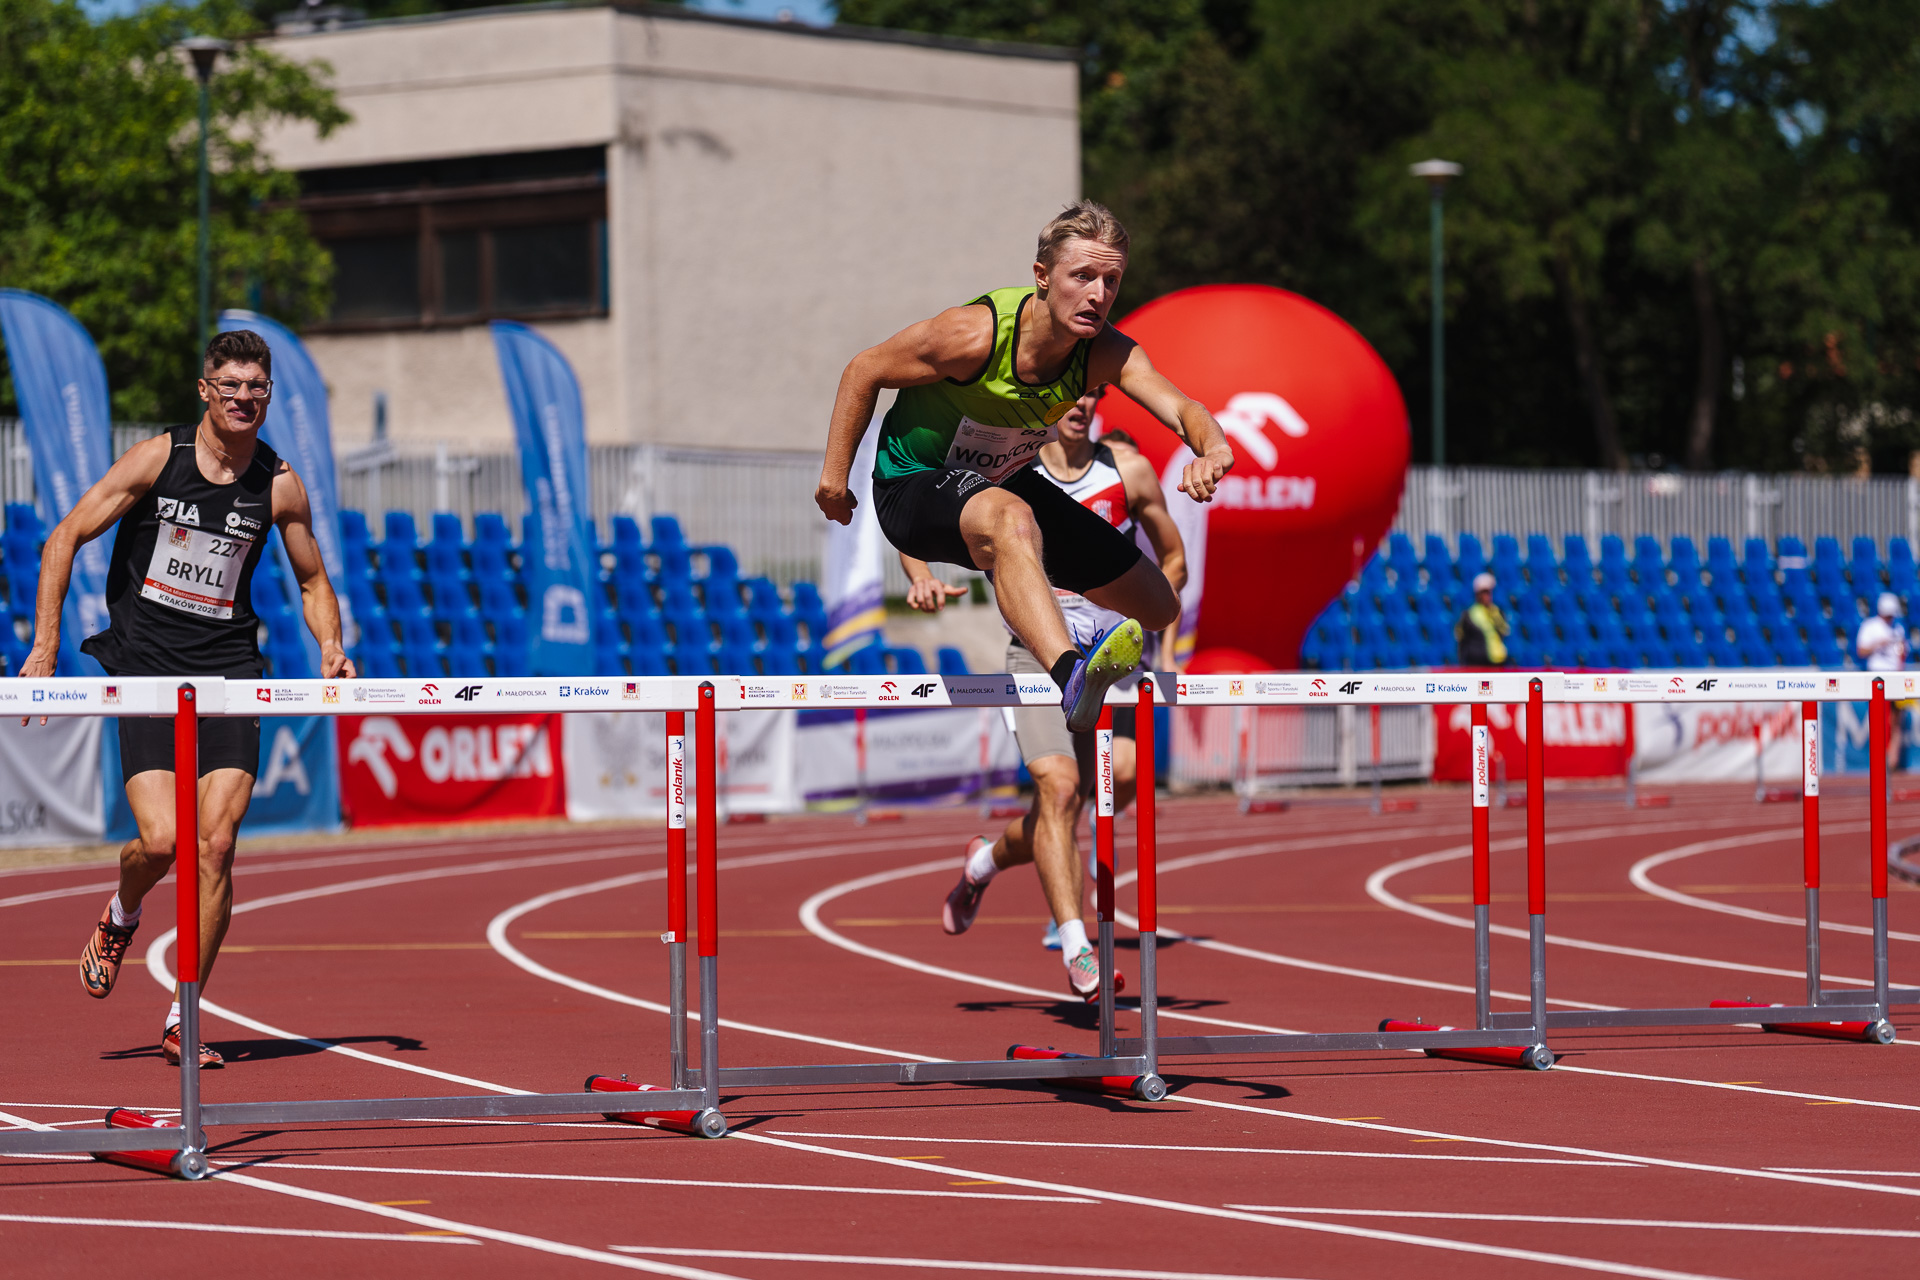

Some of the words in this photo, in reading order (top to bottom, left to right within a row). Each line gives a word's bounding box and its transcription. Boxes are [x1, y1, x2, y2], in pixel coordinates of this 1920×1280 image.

[955, 440, 1046, 469] WODECKI
[1211, 475, 1317, 510] RLEN
[241, 519, 261, 530] OPOLE
[228, 527, 257, 540] OPOLS
[208, 539, 243, 559] 227
[166, 557, 224, 589] BRYLL
[158, 593, 197, 610] KRAKÓW
[196, 604, 218, 615] 2025
[455, 685, 483, 701] 4F
[574, 686, 610, 696] Kraków
[911, 683, 937, 698] 4F
[1019, 684, 1051, 694] Kraków
[1338, 681, 1363, 695] 4F
[1438, 684, 1468, 693] Kraków
[1696, 679, 1718, 691] 4F
[1788, 681, 1816, 689] Kraków
[48, 690, 87, 701] Kraków
[419, 724, 553, 784] ORLEN
[1808, 738, 1818, 776] polanik
[1101, 750, 1113, 795] polanik
[1476, 745, 1487, 786] polanik
[672, 757, 685, 806] polanik
